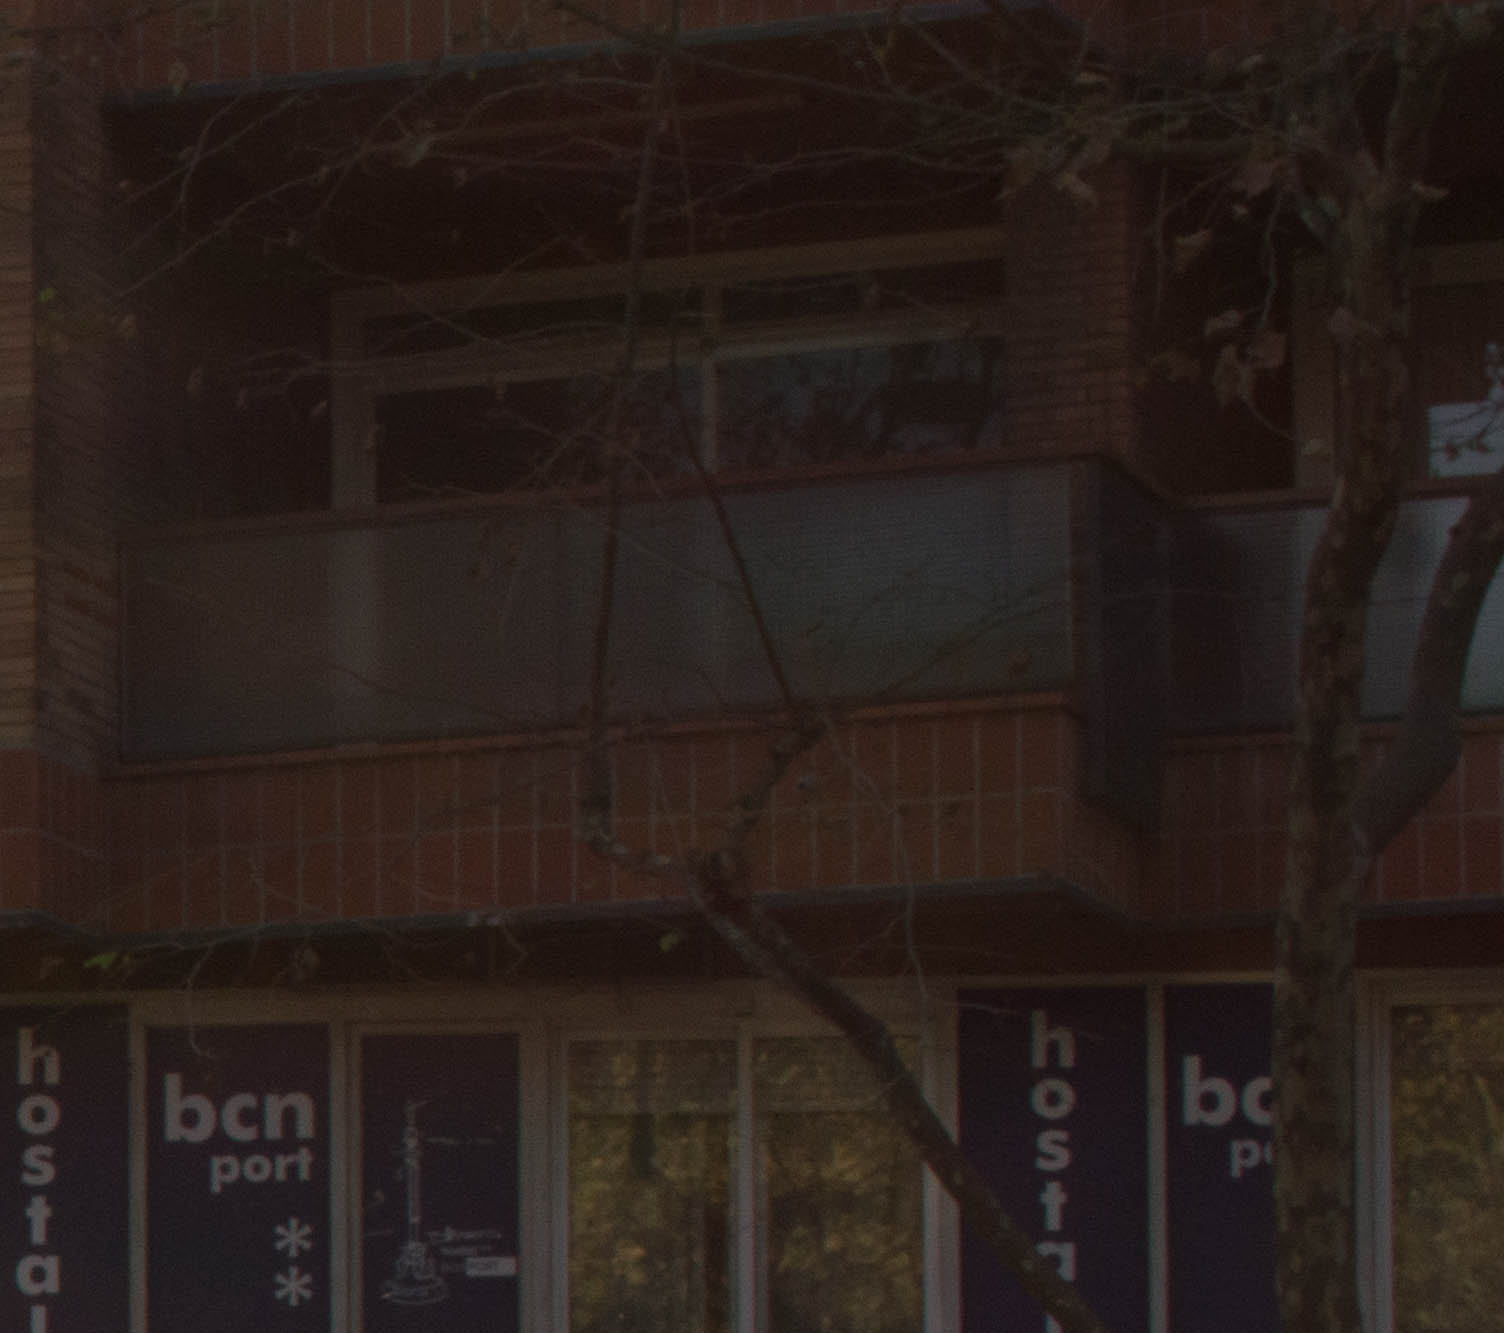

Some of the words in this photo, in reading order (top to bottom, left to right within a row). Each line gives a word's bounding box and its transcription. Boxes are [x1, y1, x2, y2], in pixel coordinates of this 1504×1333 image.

[162, 1073, 316, 1143] bcn
[1180, 1055, 1274, 1127] bc
[209, 1147, 313, 1194] port
